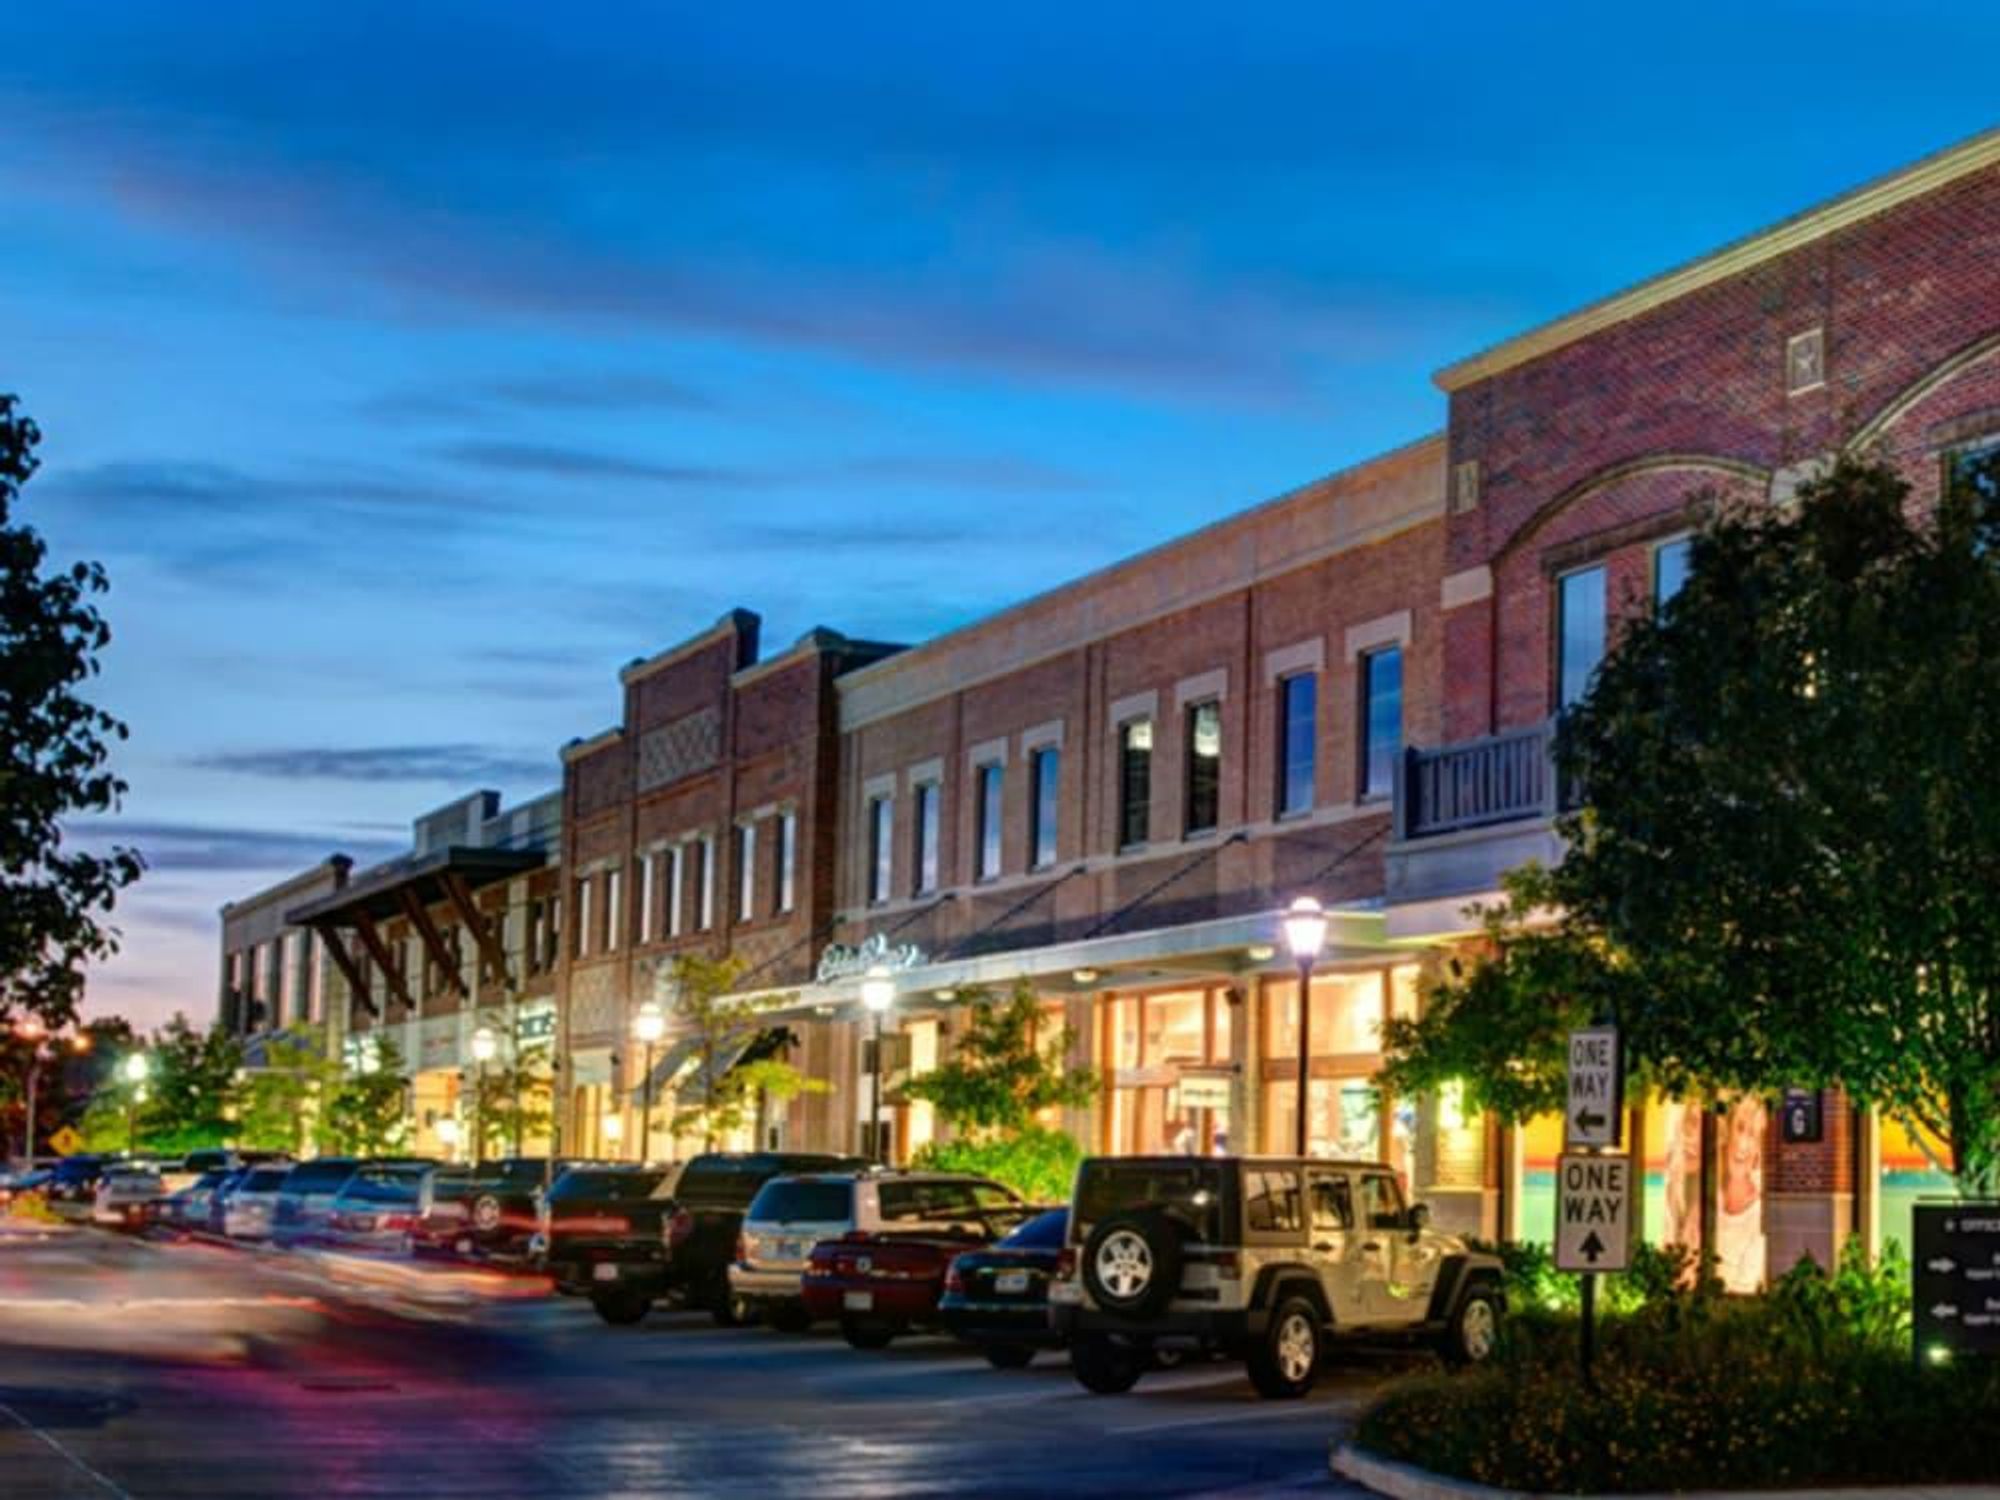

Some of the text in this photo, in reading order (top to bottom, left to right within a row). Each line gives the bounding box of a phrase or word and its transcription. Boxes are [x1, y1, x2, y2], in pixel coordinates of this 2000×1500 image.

[1574, 1039, 1609, 1067] ONE
[1572, 1071, 1609, 1099] WAY
[1567, 1163, 1623, 1191] ONE
[1564, 1196, 1623, 1223] WAY
